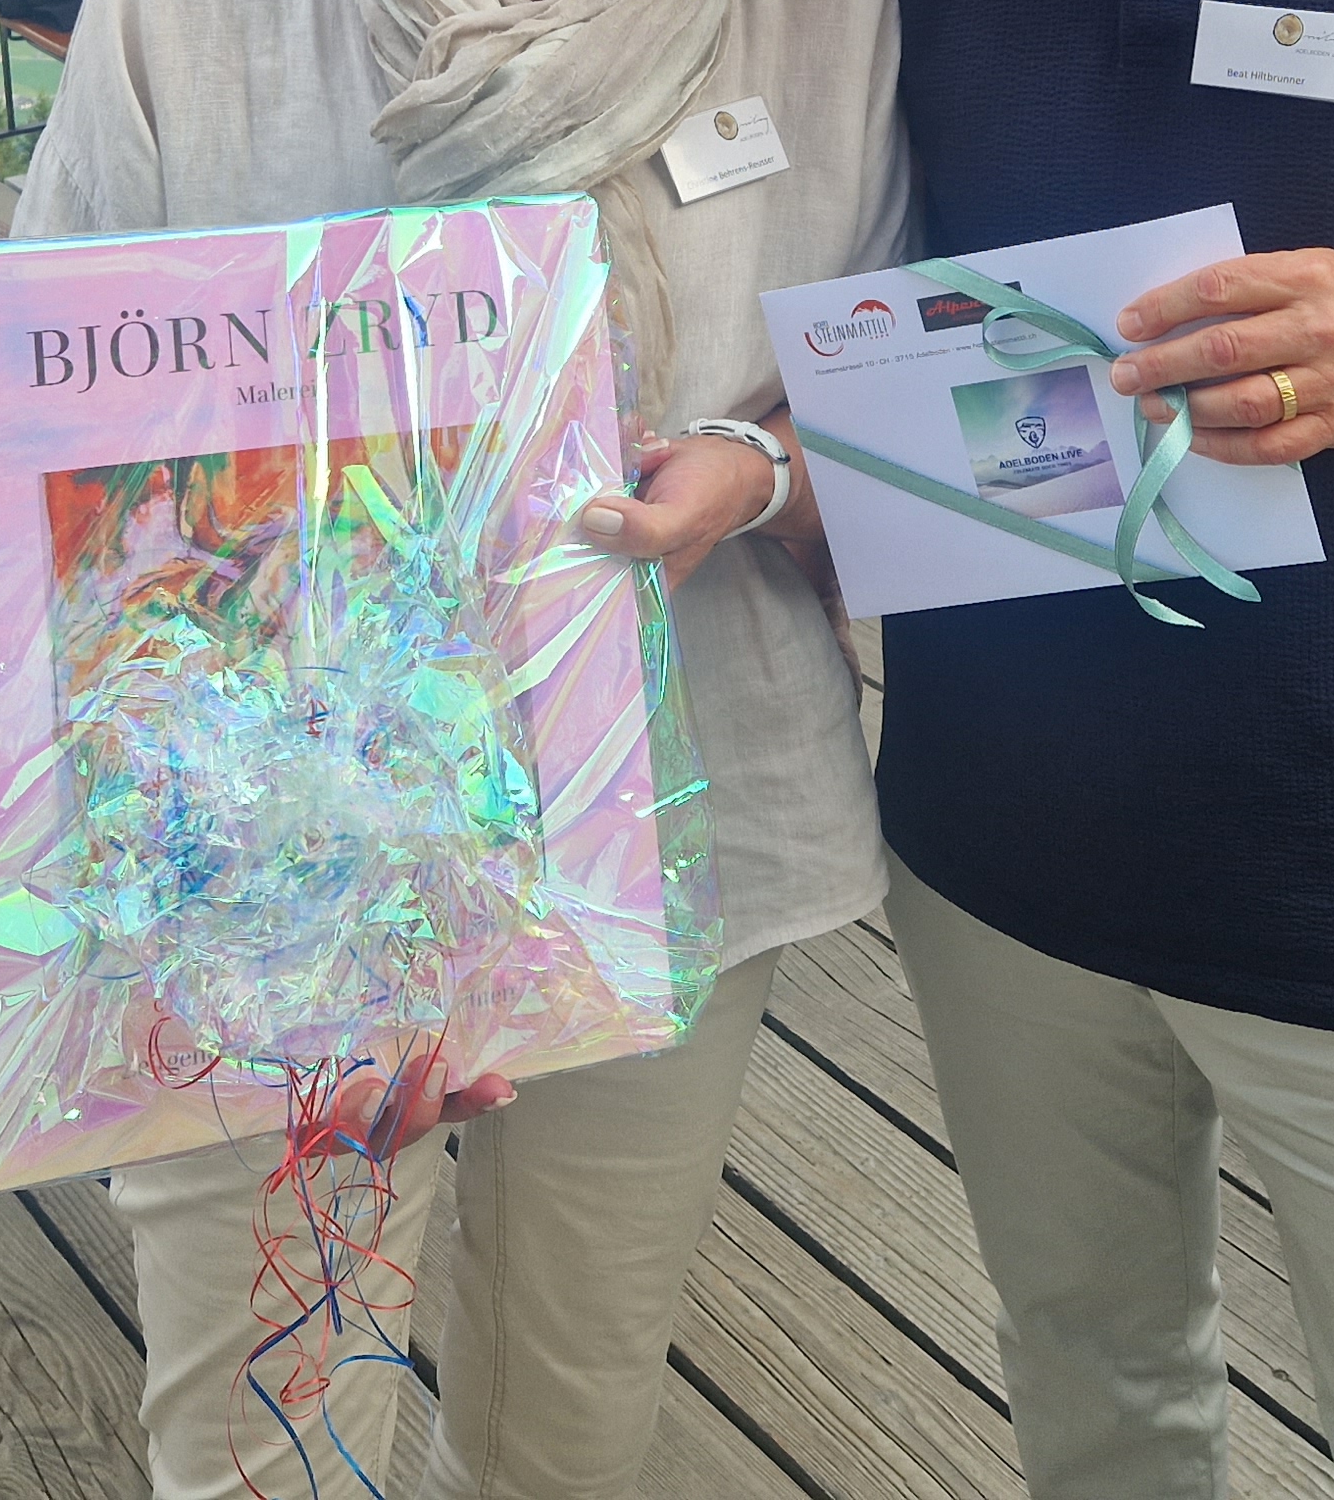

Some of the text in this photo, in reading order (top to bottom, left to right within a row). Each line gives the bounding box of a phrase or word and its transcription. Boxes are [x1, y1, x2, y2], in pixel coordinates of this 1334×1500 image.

[1227, 68, 1306, 85] Beat Hiltbrunner
[718, 156, 775, 181] Behrens-Reusser
[26, 289, 499, 394] BJÖRN ZRYD
[814, 317, 888, 345] STEINMATTLI
[235, 381, 318, 407] Malerei
[999, 448, 1084, 470] ADELBODEN LIVE
